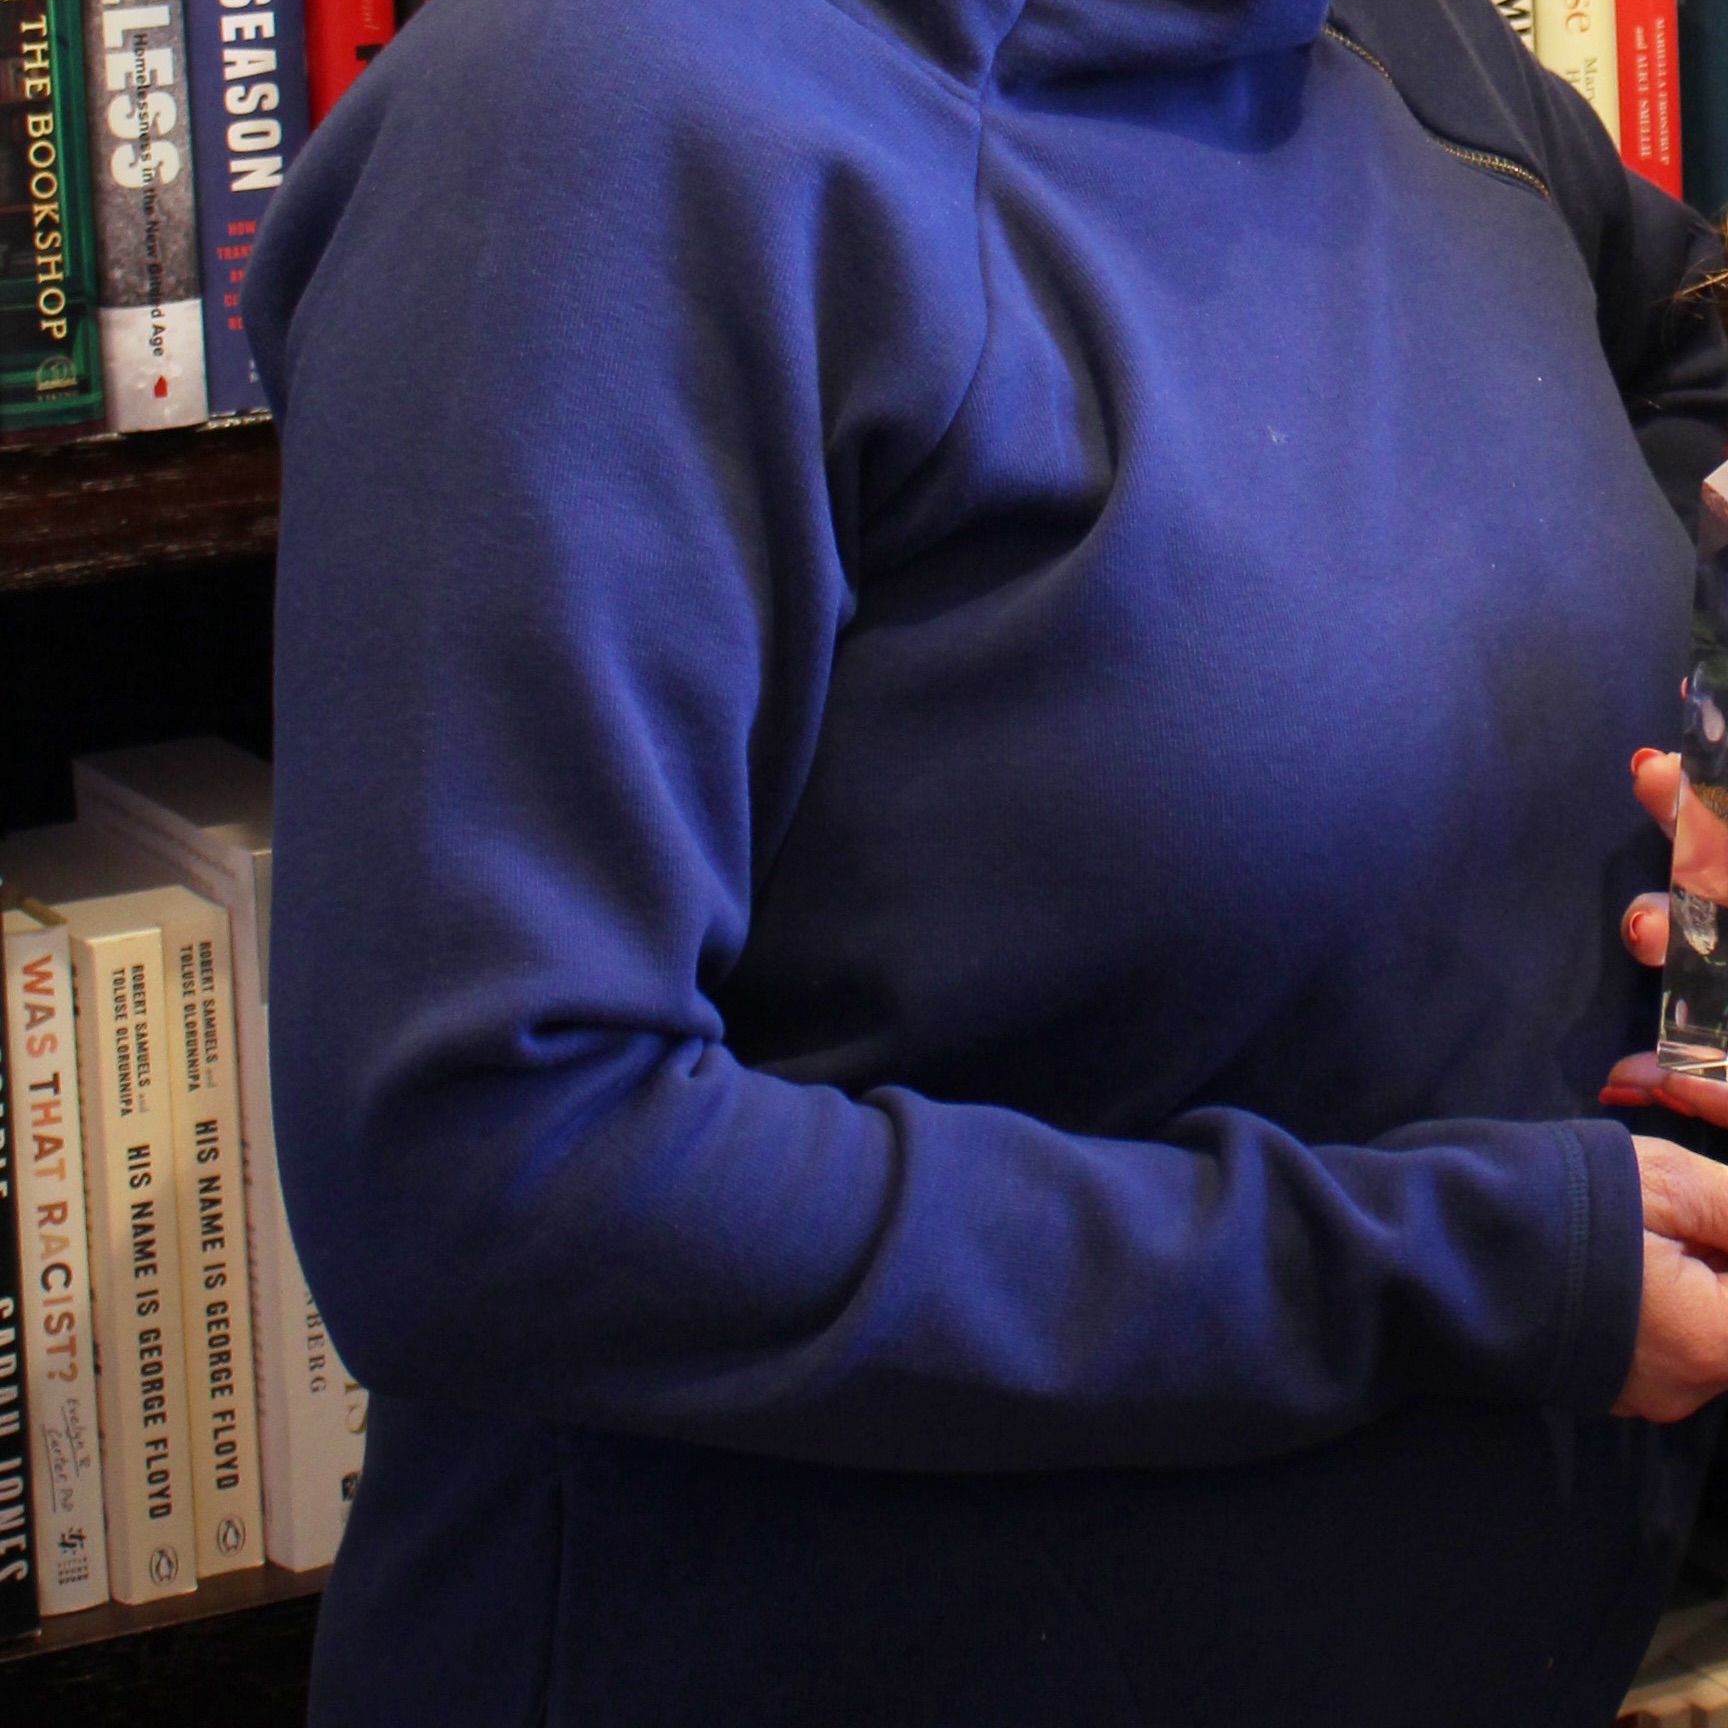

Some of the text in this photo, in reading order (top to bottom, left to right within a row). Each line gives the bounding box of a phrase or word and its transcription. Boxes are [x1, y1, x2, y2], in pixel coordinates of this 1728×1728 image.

[20, 15, 68, 341] THE BOOKSHOP
[133, 33, 166, 357] Homelessness Age
[113, 968, 127, 1021] TOLUSE
[132, 964, 151, 1088] ROBERT SAMUELS
[180, 945, 196, 997] TOLUSE
[200, 941, 218, 1064] ROBERT SAMUELS
[21, 954, 79, 1383] WAS THAT RACIST?
[194, 1119, 240, 1490] HIS NAME IS GEORGE FLOYD
[127, 1143, 172, 1521] HIS NAME IS GEORGE FLOYD
